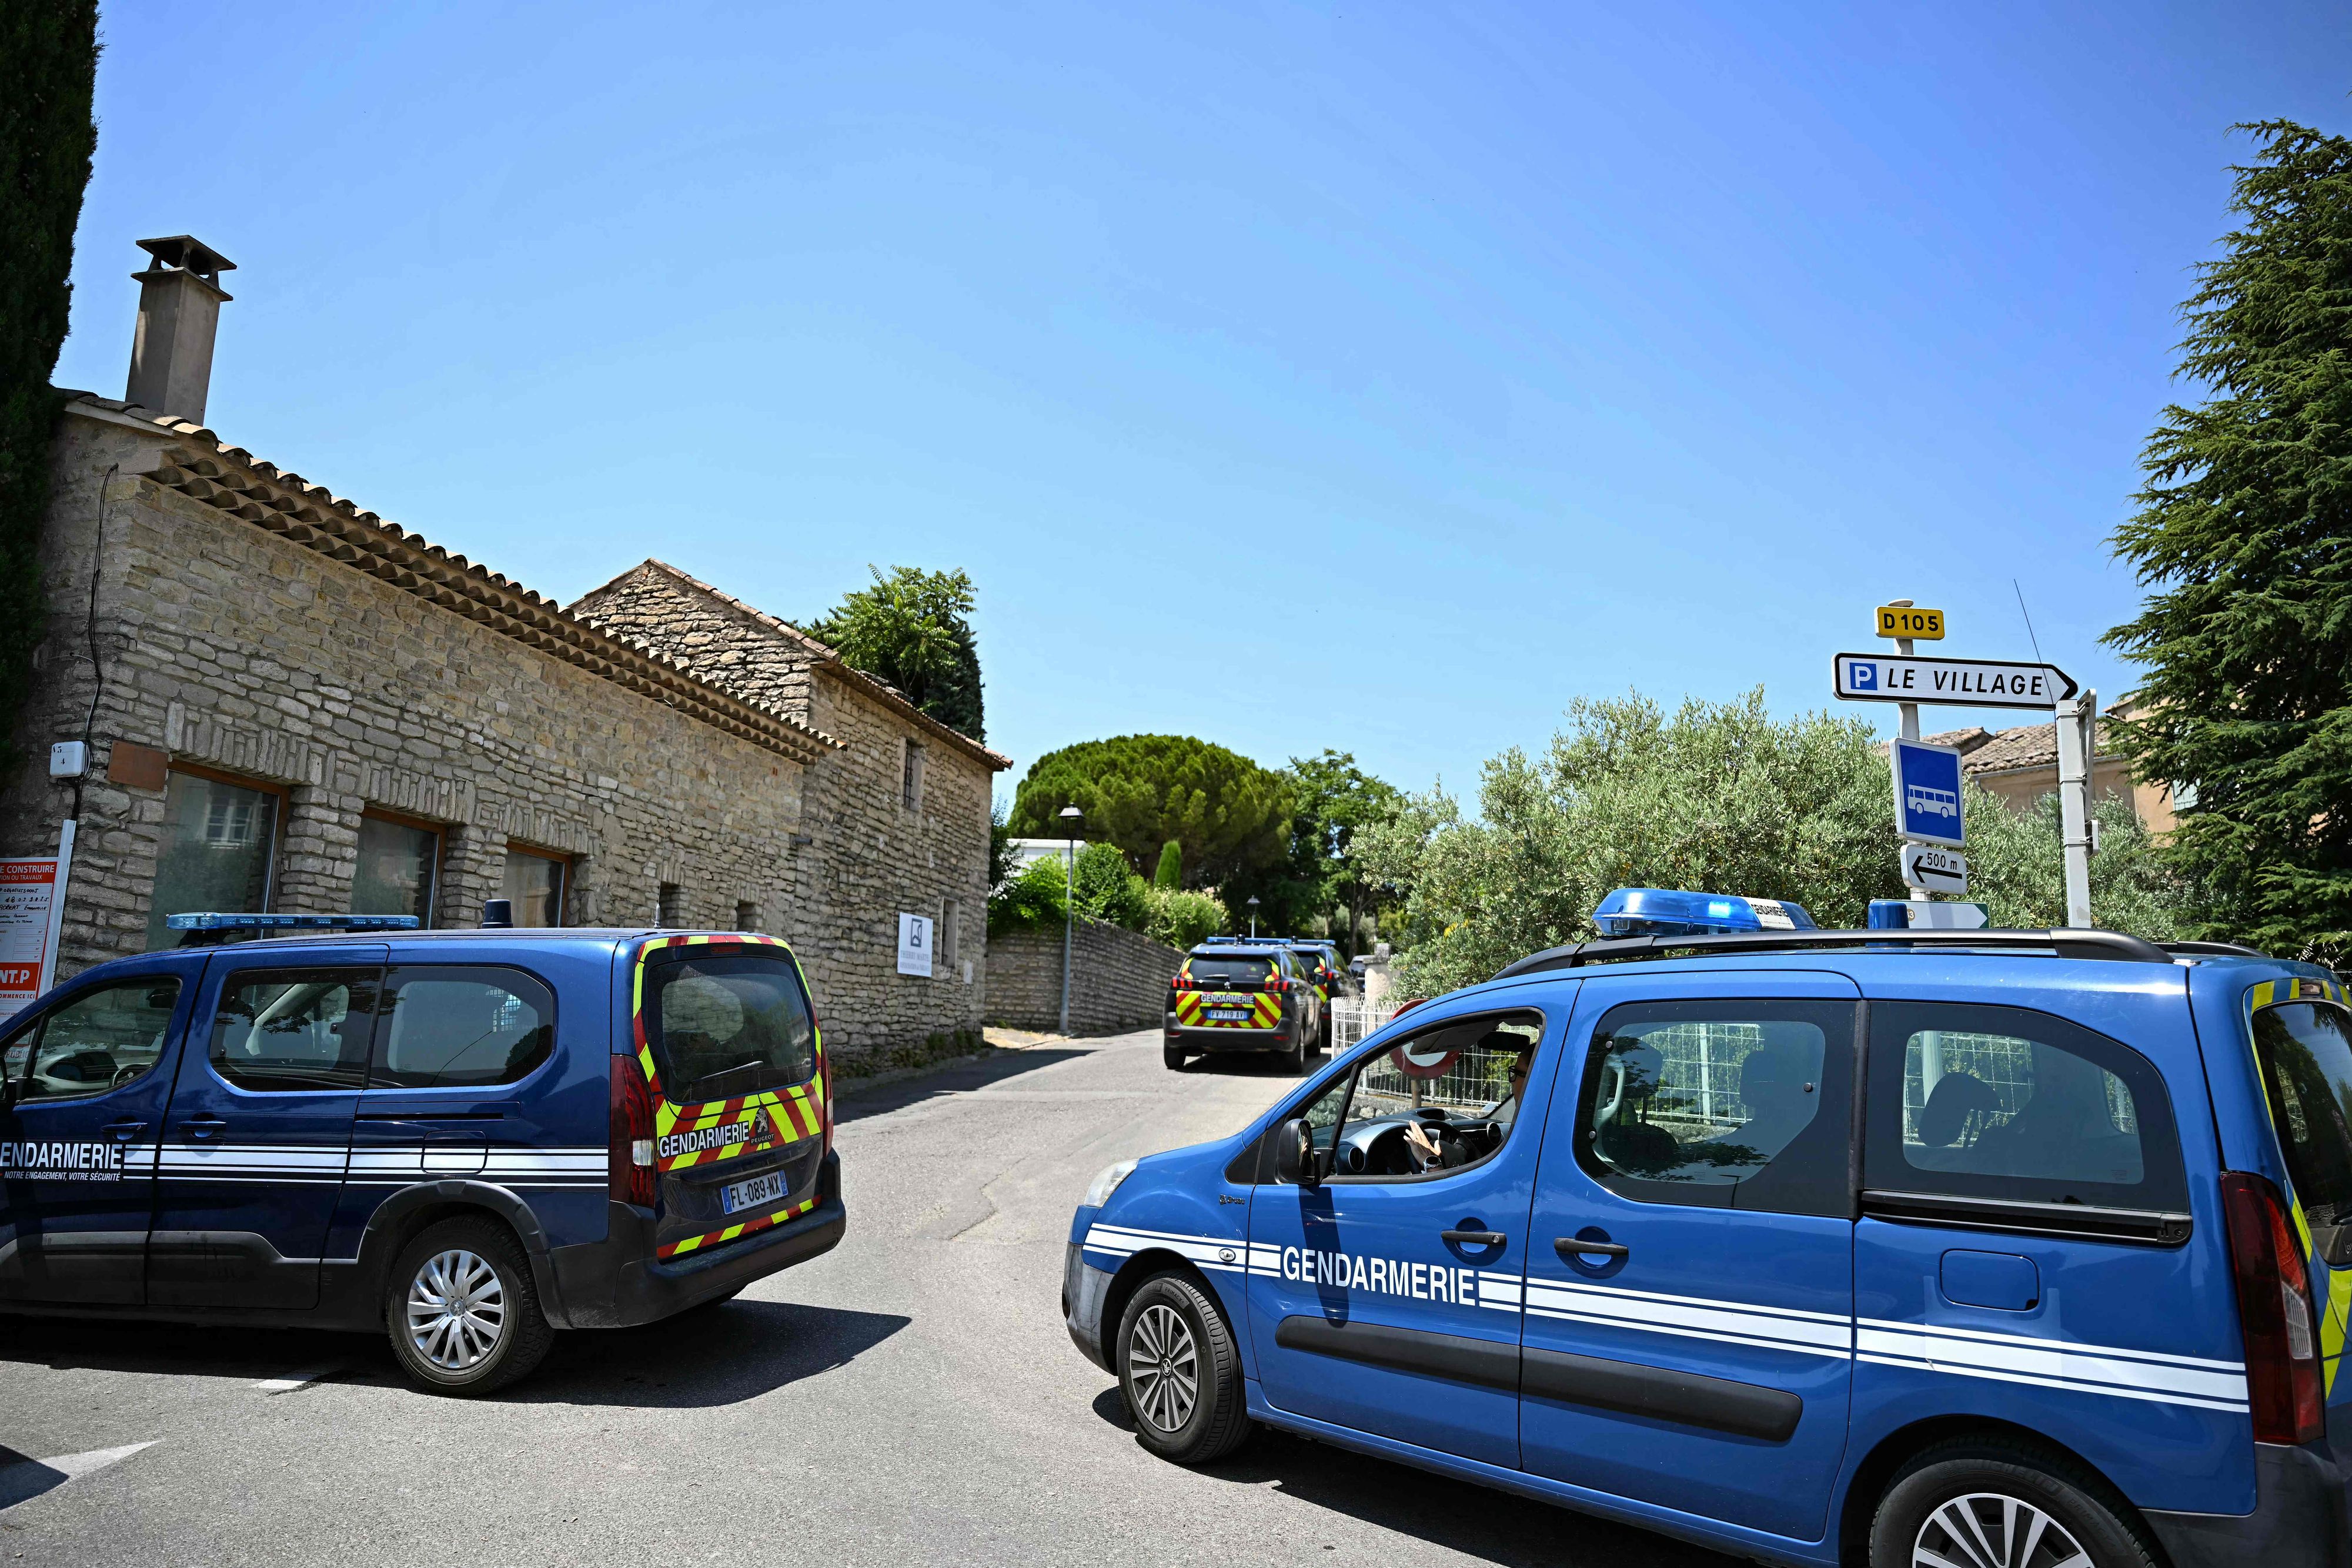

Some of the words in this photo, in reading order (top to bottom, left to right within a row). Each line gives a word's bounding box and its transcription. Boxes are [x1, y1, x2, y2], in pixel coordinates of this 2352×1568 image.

[1854, 666, 1872, 688] P
[1887, 668, 1915, 689] LE
[1933, 670, 2043, 696] VILLAGE
[1927, 852, 1946, 868] 500
[1950, 860, 1957, 870] m
[6, 865, 55, 874] CONSTRUIRE
[1750, 904, 1789, 917] GENDARMERIE
[1201, 994, 1254, 1004] GENDARMERIE
[659, 1122, 749, 1158] GENDARMERIE
[751, 1134, 774, 1144] PEUGEOT
[4, 1171, 24, 1179] NOTRE
[25, 1171, 68, 1182] ENGAGEMENT,
[69, 1172, 89, 1181] VOTRE
[89, 1171, 121, 1181] SÉCURITÉ
[1283, 1246, 1475, 1306] GENDARMERIE
